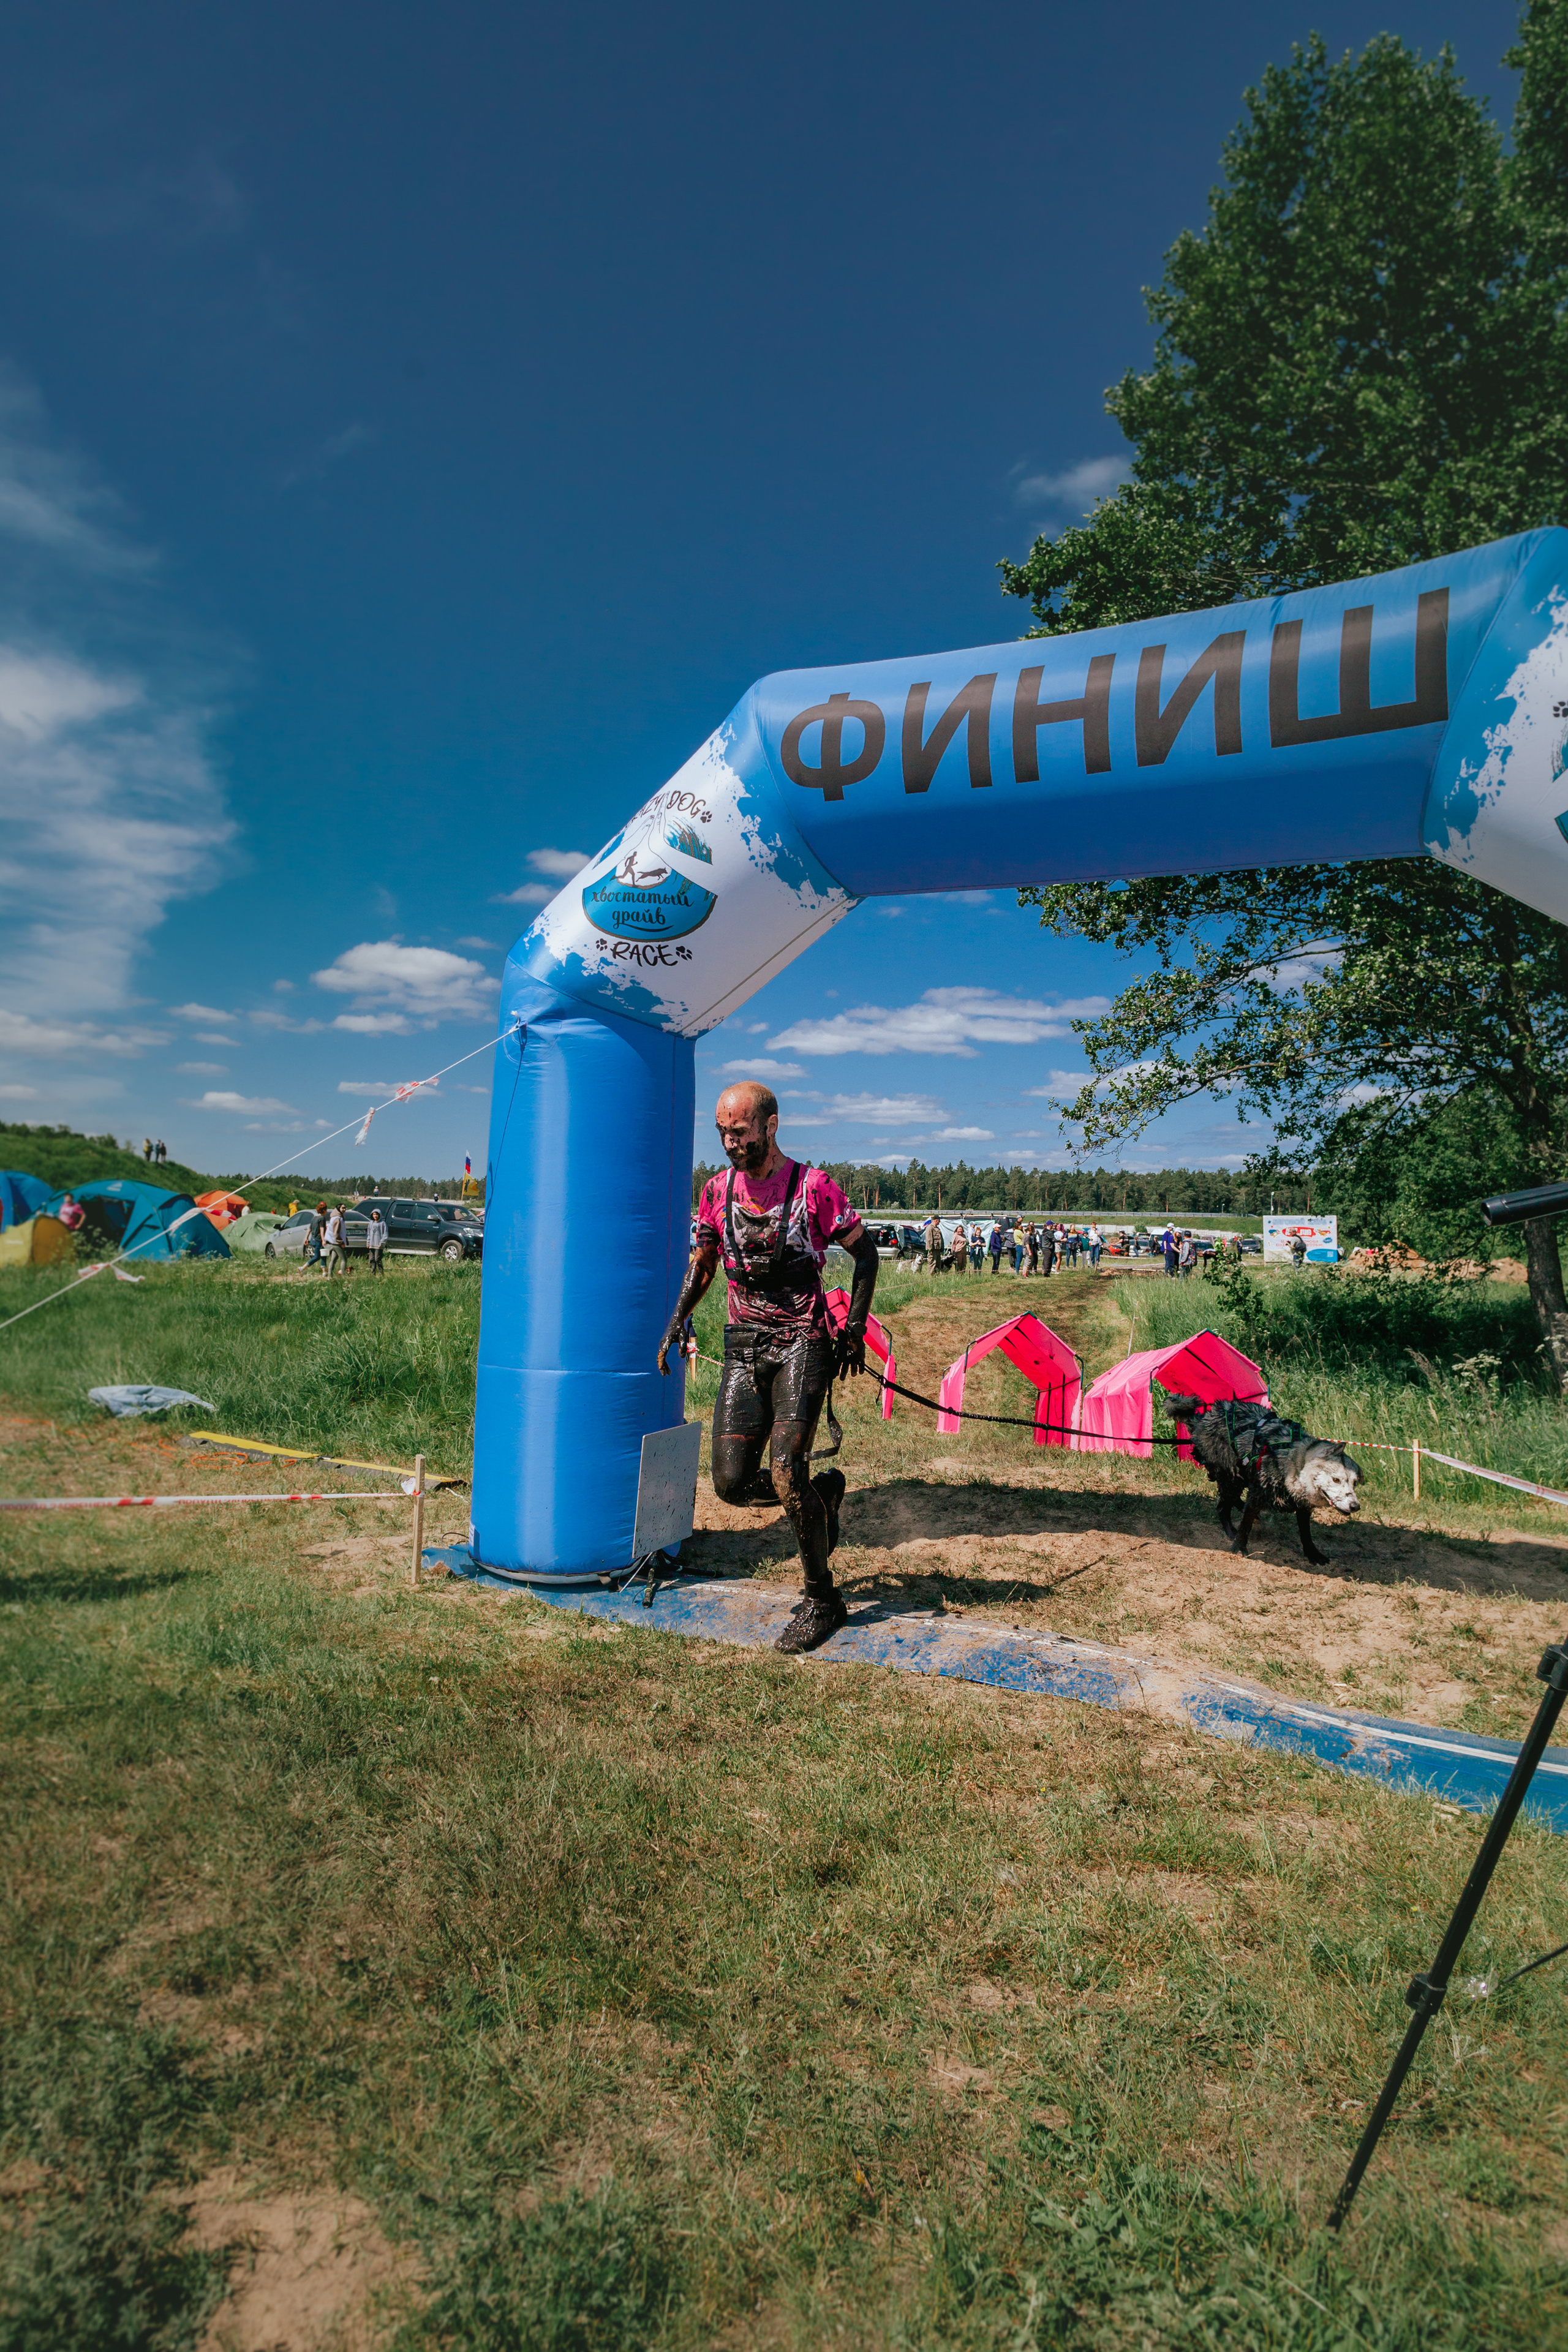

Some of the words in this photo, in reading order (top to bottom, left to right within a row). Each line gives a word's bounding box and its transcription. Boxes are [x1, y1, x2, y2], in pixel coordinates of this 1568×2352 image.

[780, 587, 1449, 802] ФИНИШ
[666, 790, 706, 818] DOG
[611, 907, 674, 932] драйв
[610, 941, 678, 967] RACE
